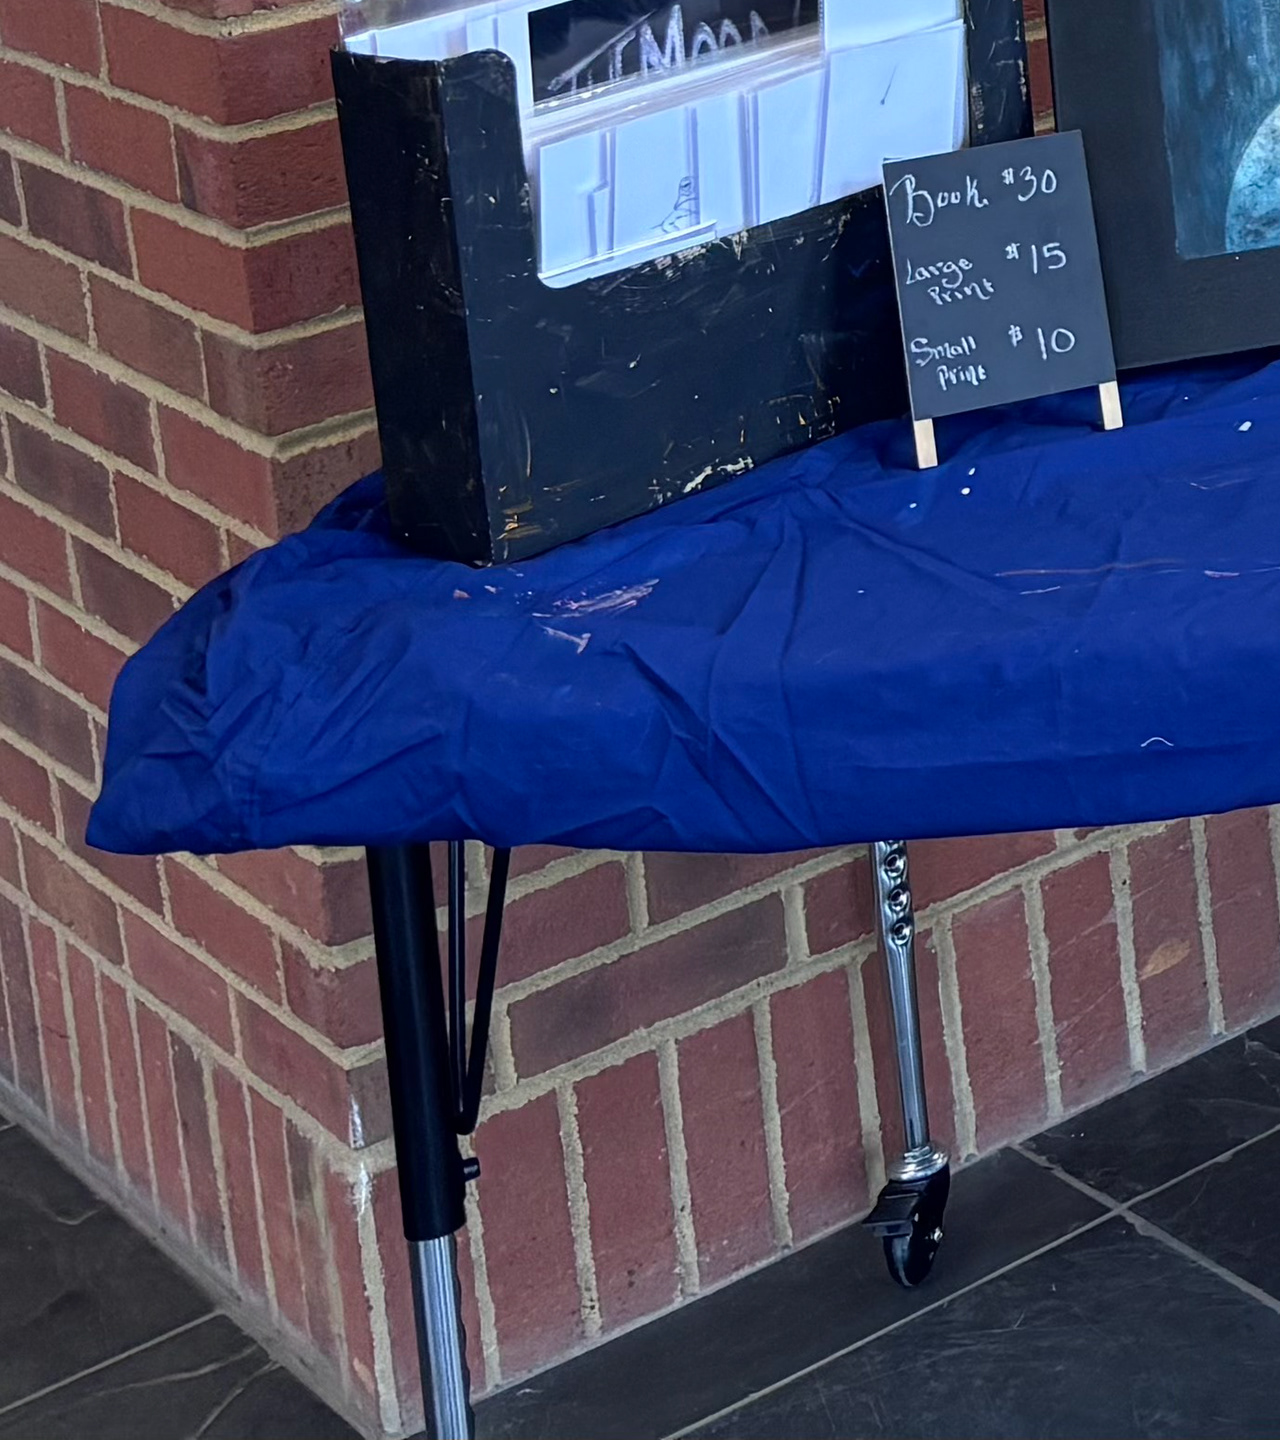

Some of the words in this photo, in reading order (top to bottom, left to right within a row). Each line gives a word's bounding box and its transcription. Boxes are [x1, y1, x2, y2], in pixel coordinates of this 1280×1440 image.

[890, 174, 988, 226] Book
[906, 258, 973, 288] Large
[910, 335, 976, 367] Small
